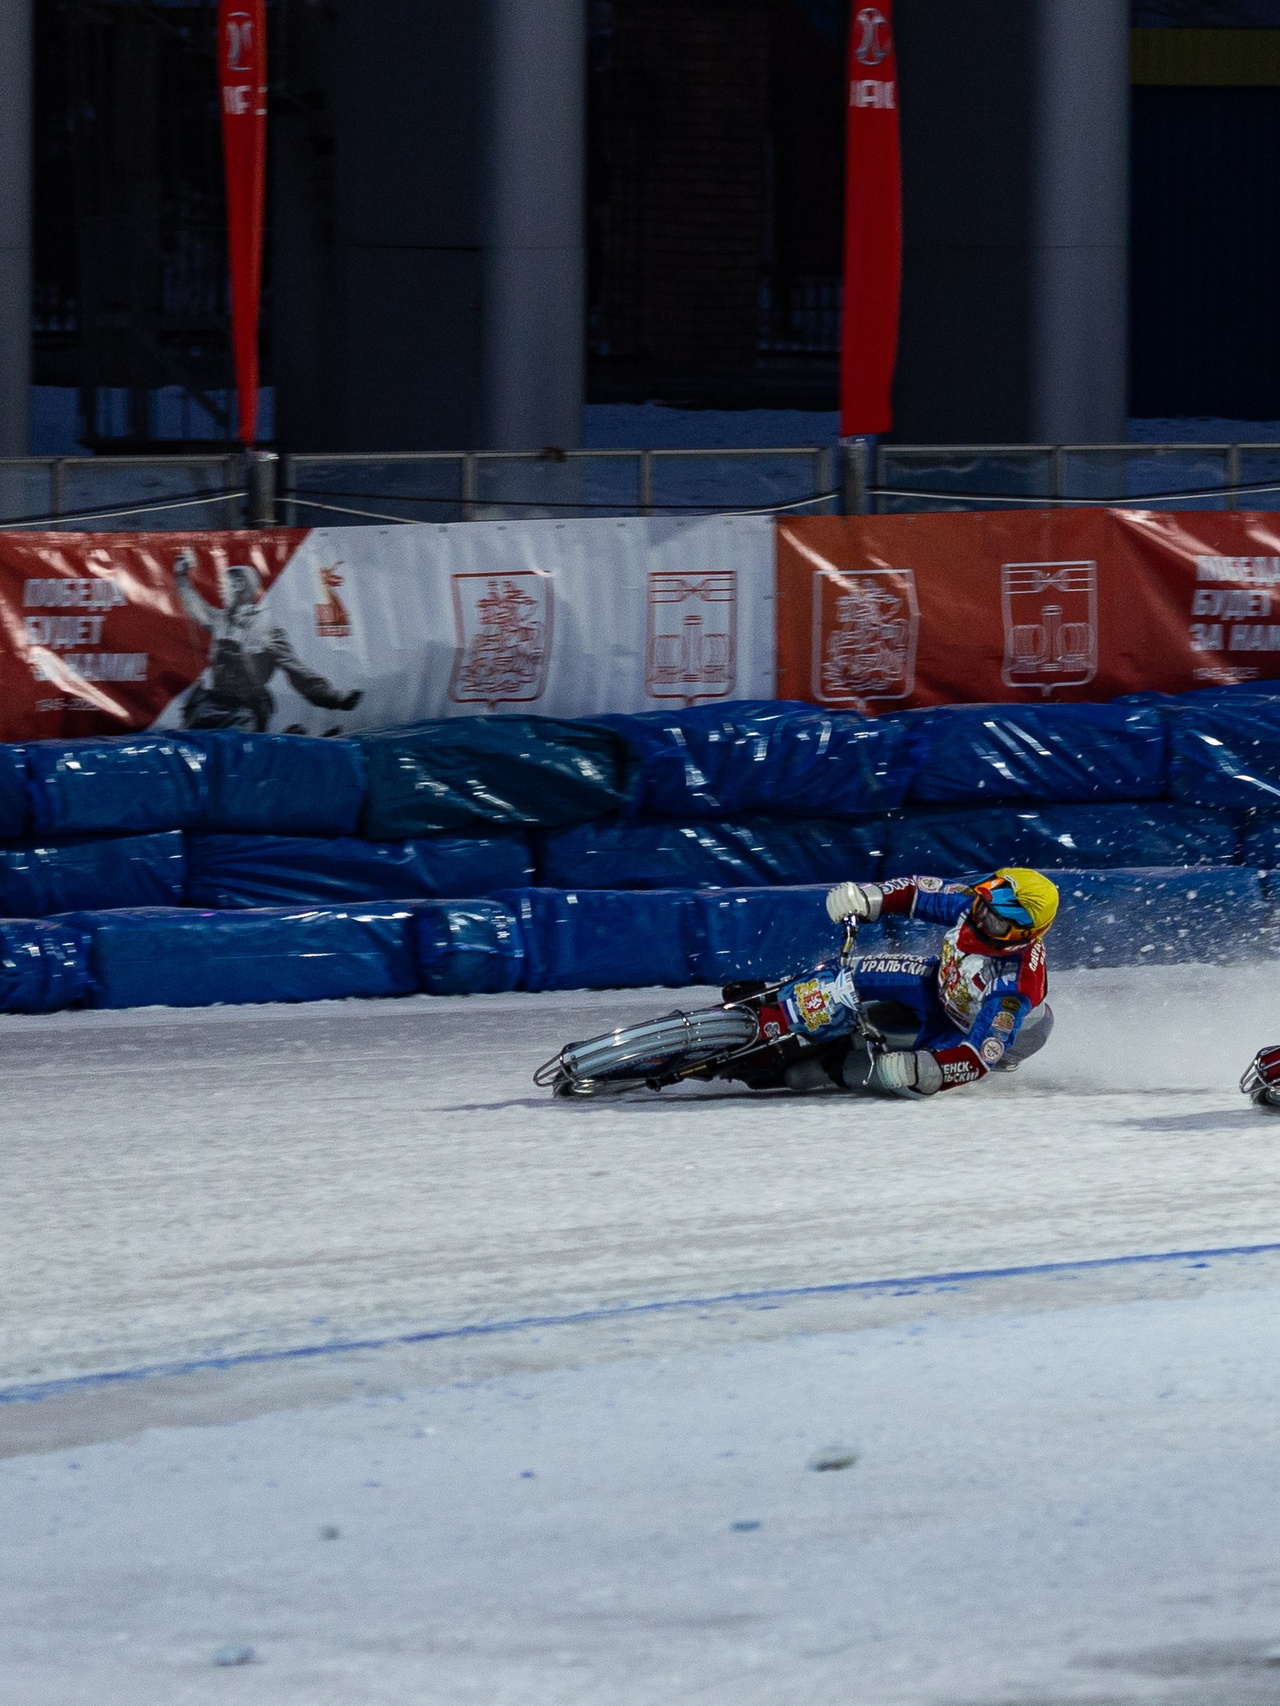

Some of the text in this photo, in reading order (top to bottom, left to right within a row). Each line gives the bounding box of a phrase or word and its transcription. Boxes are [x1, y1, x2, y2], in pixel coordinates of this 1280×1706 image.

[24, 578, 126, 611] ПОБЕДА
[1191, 589, 1272, 620] БУДЕТ
[25, 615, 106, 649] БУДЕТ
[1189, 623, 1224, 651] ЗА
[941, 1061, 974, 1074] ЕНСК-
